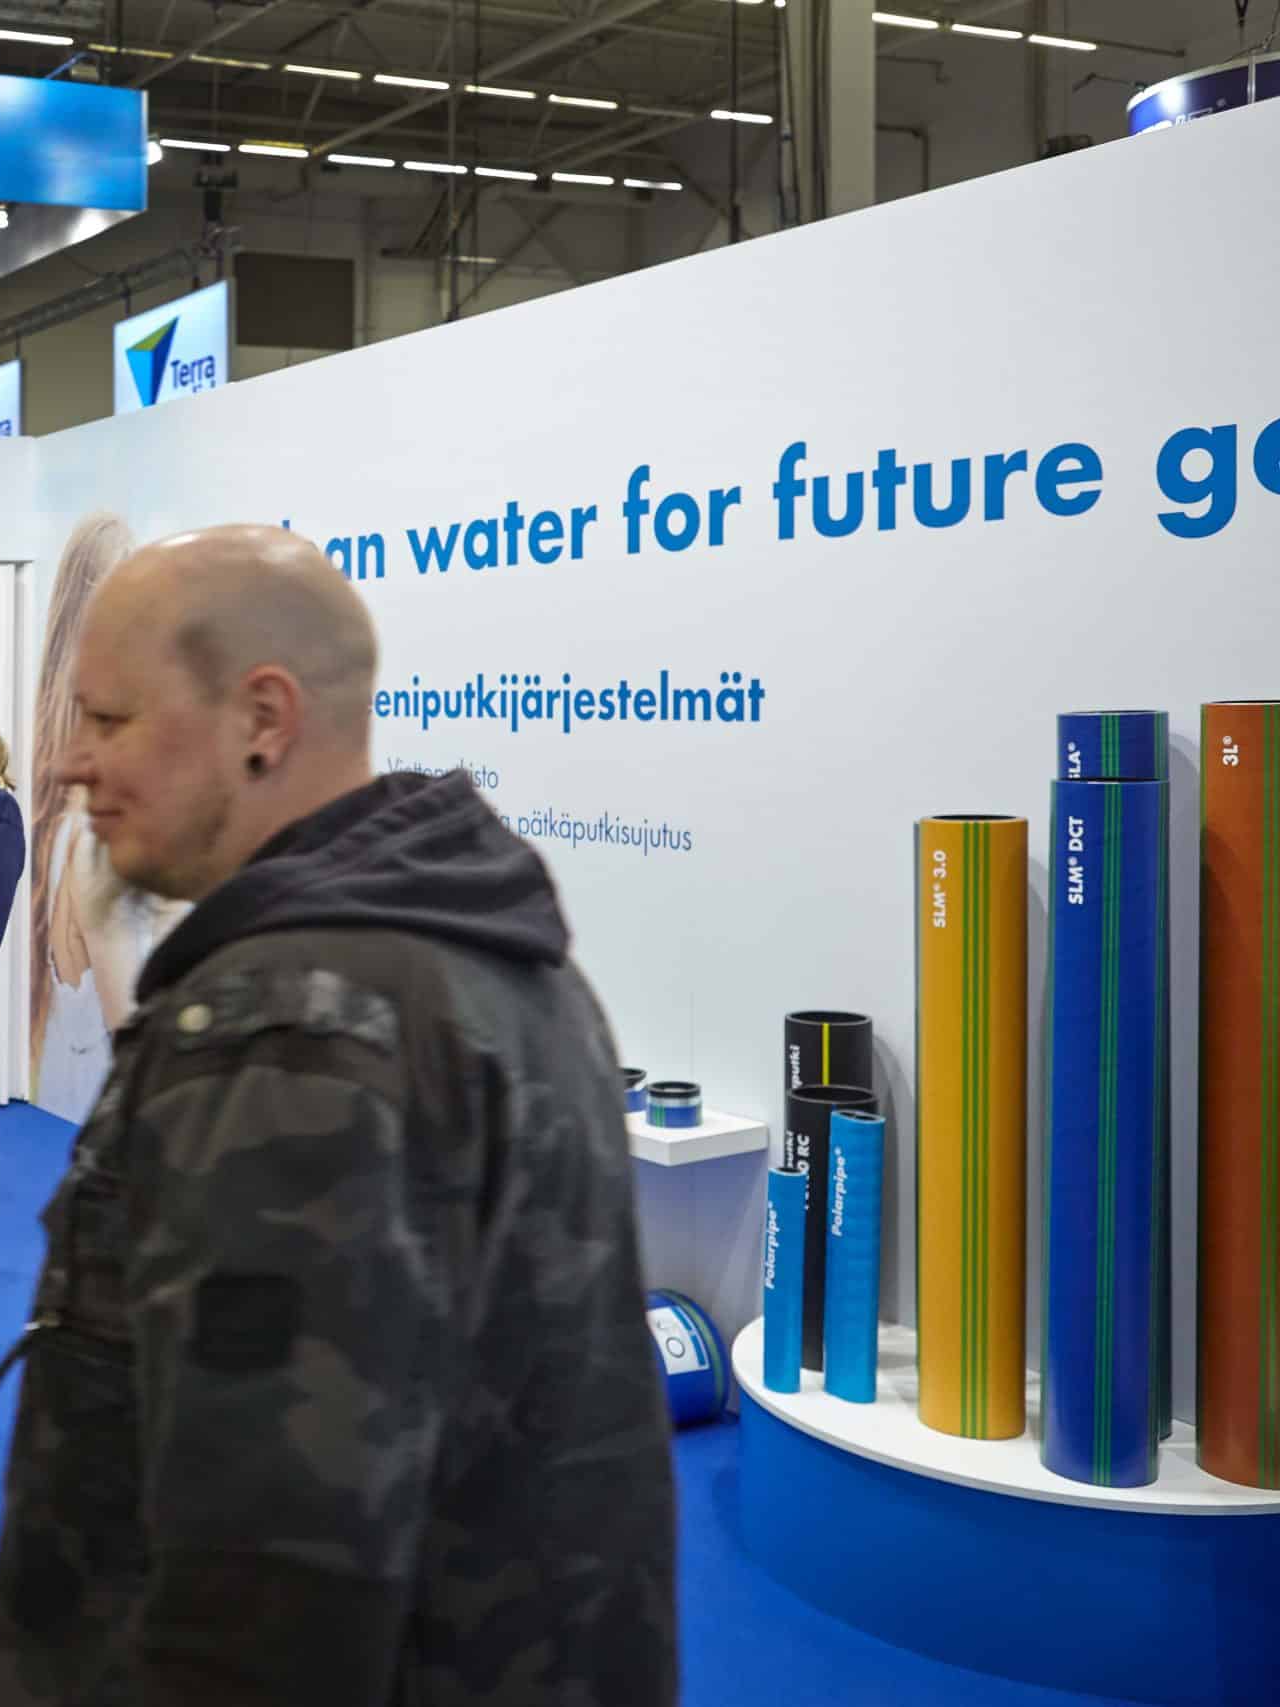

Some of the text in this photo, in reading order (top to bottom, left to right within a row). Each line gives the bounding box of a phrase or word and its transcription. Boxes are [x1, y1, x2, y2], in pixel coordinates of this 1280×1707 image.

[170, 355, 215, 389] Terra
[406, 501, 598, 575] water
[623, 465, 741, 554] for
[773, 441, 1103, 540] future
[374, 670, 767, 735] eniputkijärjestelmät
[518, 807, 693, 857] pätkäputkisujutus
[1067, 816, 1084, 852] DCT
[932, 849, 947, 880] 3.0
